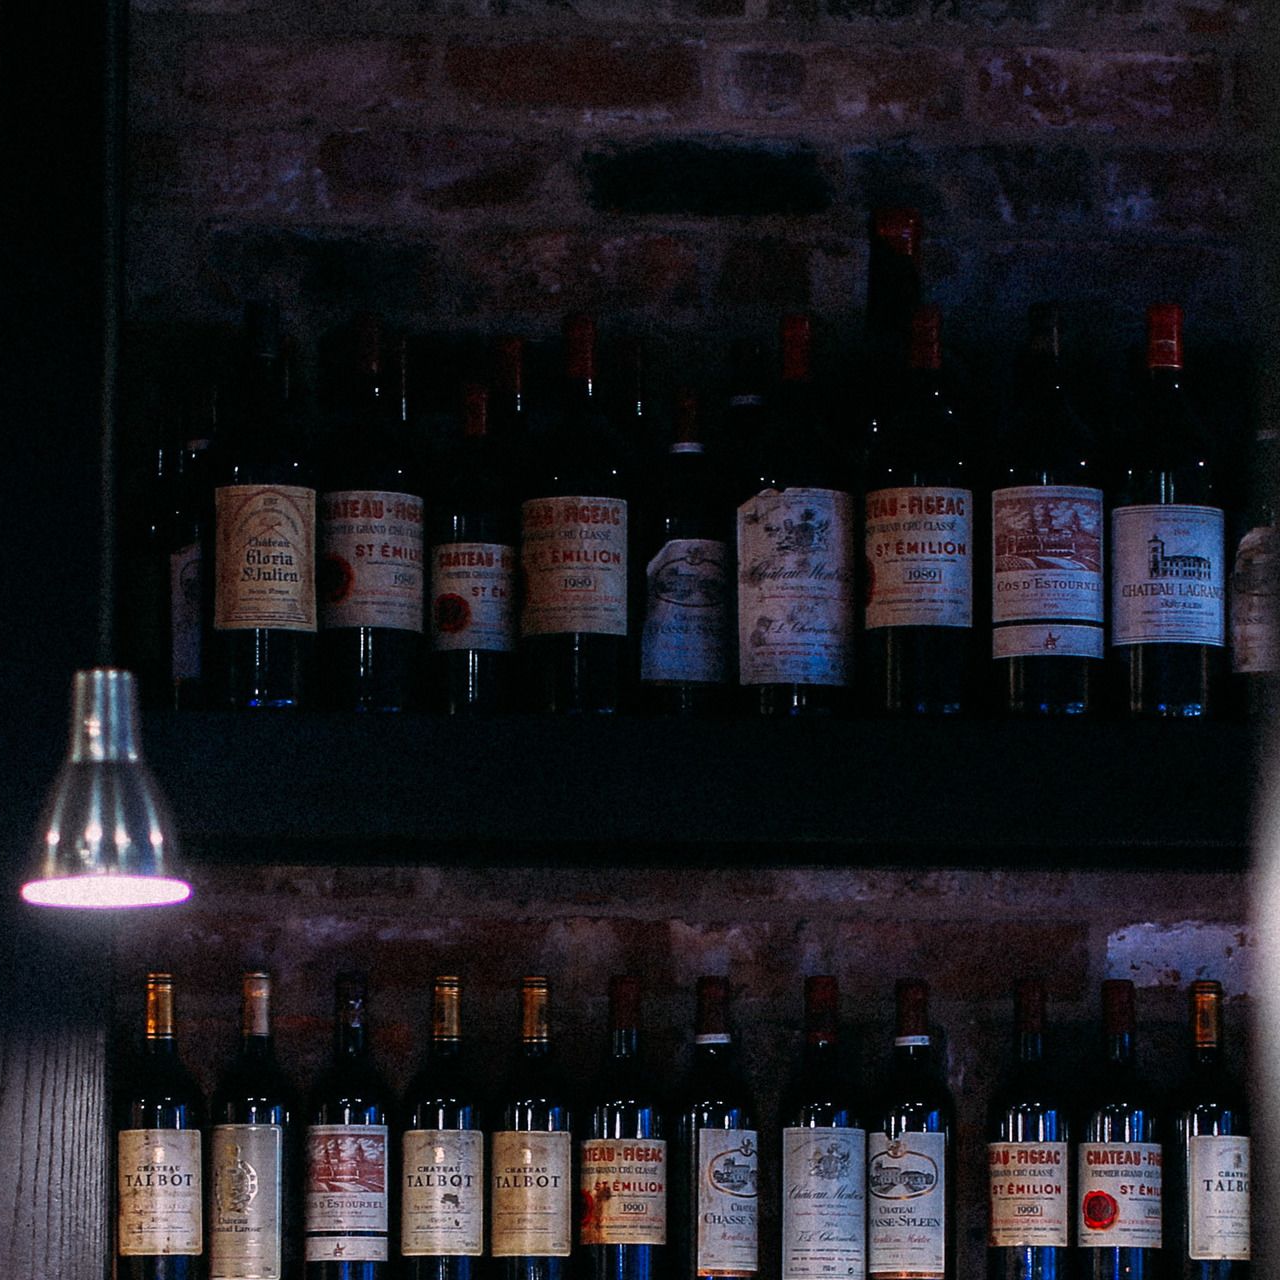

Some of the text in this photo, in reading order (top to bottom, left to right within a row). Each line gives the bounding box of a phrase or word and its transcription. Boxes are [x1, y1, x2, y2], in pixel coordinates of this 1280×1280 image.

[246, 549, 294, 565] Gloria
[908, 569, 937, 582] 1989
[1122, 582, 1174, 598] CHATEAU
[125, 1174, 194, 1187] TALBOT
[407, 1174, 474, 1187] TALBOT
[495, 1175, 561, 1188] TALBOT
[613, 1180, 663, 1193] ÉMILION
[1008, 1183, 1061, 1195] ÉMILION
[623, 1203, 644, 1212] 1990
[879, 1206, 916, 1214] CHATEAU
[1017, 1206, 1039, 1214] 1990
[870, 1215, 941, 1227] ASSE-SPLEEN
